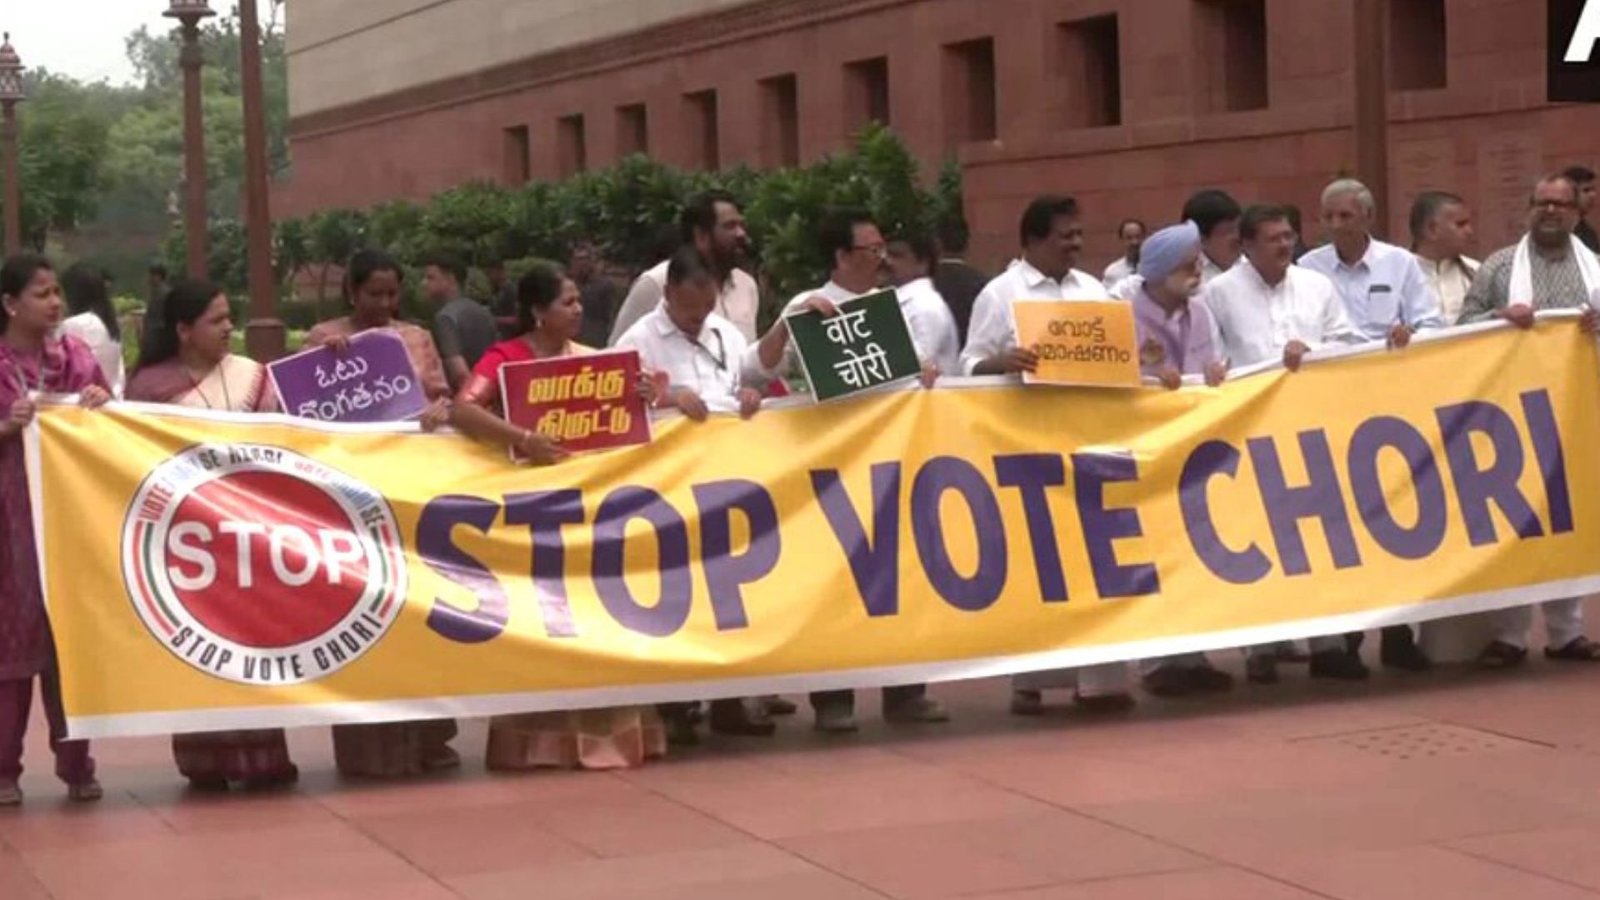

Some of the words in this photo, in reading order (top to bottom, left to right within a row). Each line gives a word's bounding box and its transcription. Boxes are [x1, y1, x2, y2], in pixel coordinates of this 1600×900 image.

[820, 305, 872, 345] वोट
[315, 356, 369, 388] ఓటు
[527, 365, 625, 404] வாக்கு
[833, 342, 892, 387] चोरी
[139, 484, 174, 522] VOTE
[414, 476, 782, 644] STOP
[808, 450, 1161, 619] VOTE
[1176, 387, 1574, 586] CHORI
[169, 520, 363, 590] STOP
[171, 627, 232, 671] STOP
[243, 655, 305, 680] VOTE
[313, 614, 382, 670] CHORI
